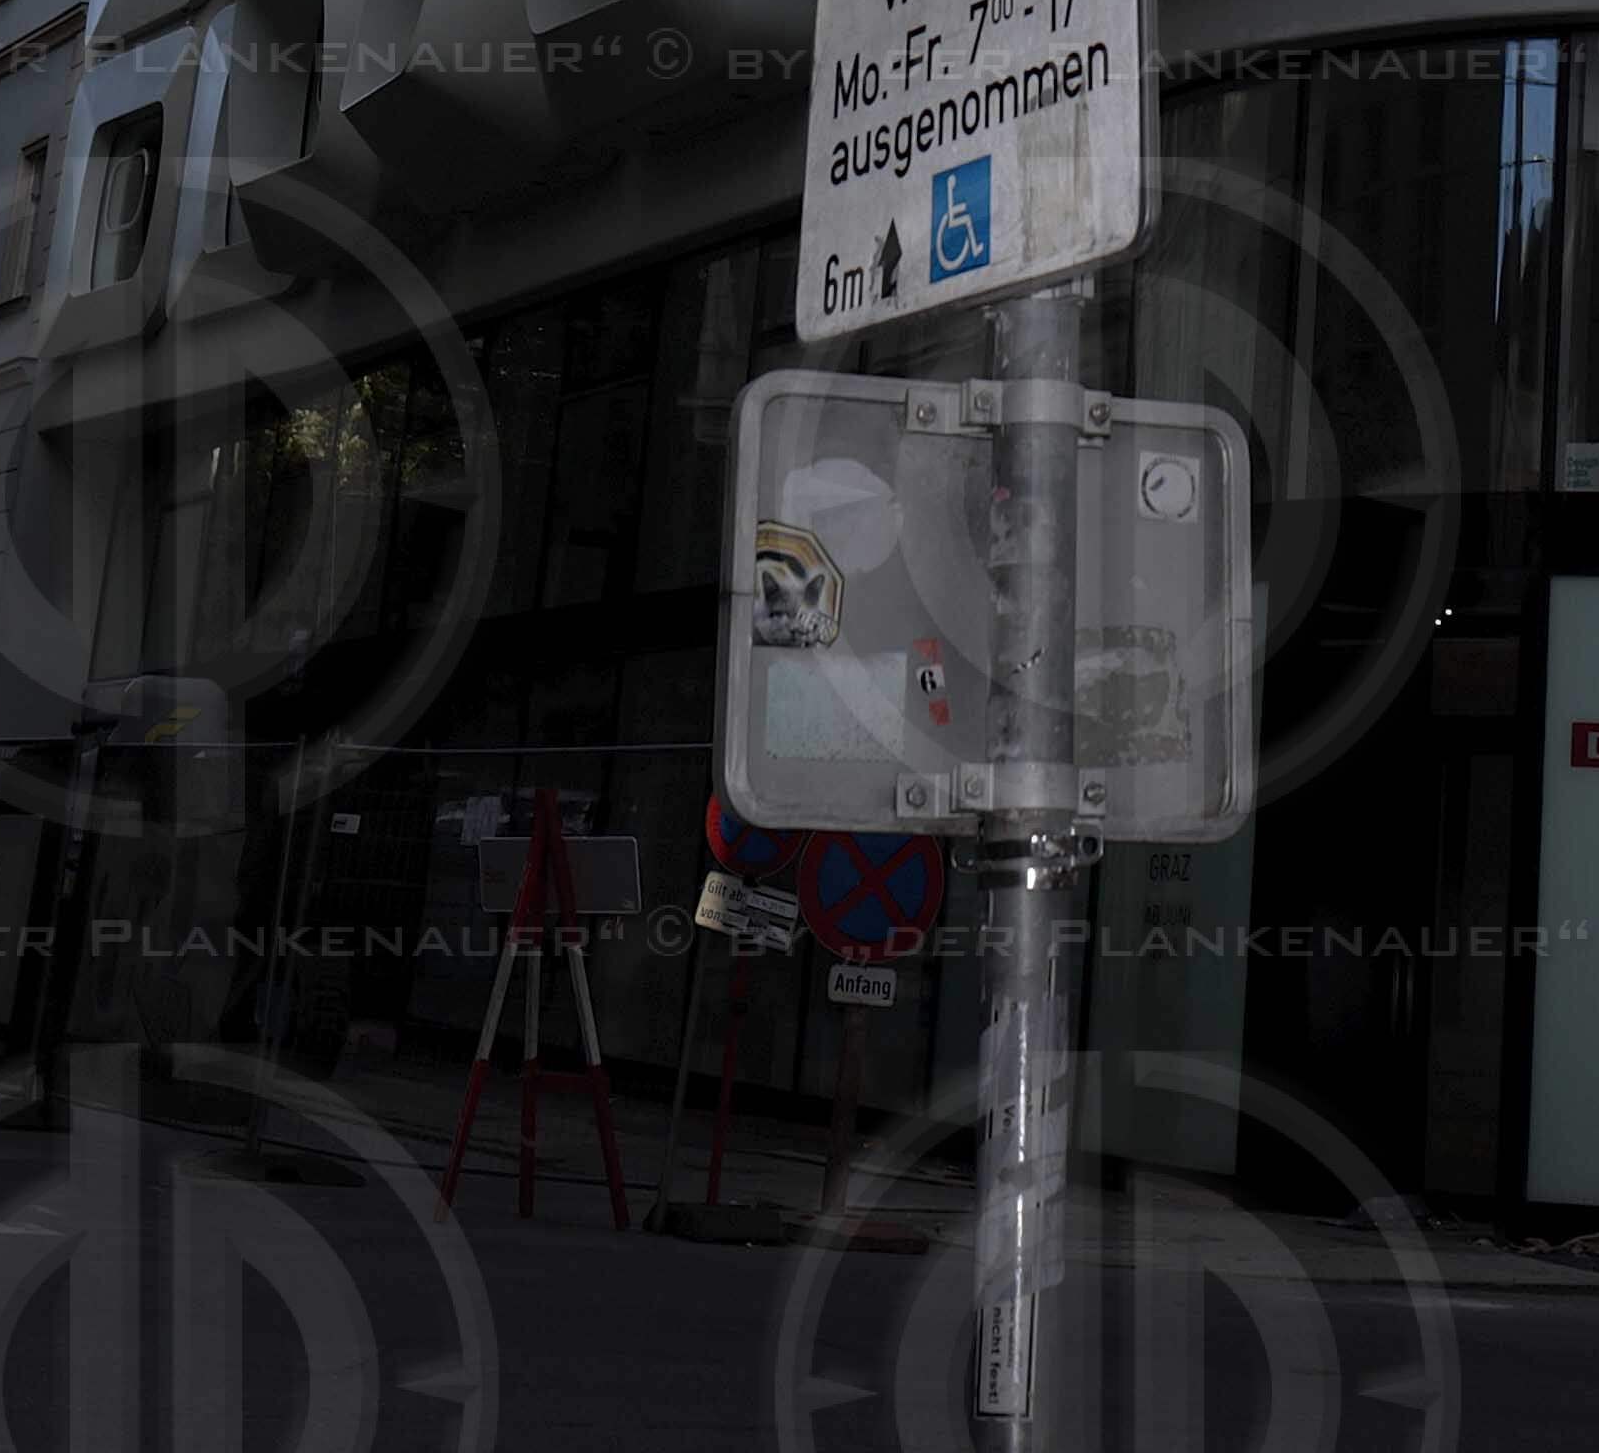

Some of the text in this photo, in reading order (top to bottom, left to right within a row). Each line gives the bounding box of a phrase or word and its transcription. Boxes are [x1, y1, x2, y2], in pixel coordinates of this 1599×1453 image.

[830, 41, 1110, 186] ausgenommen
[1149, 853, 1193, 882] GRAZ
[834, 972, 892, 1000] Anfang
